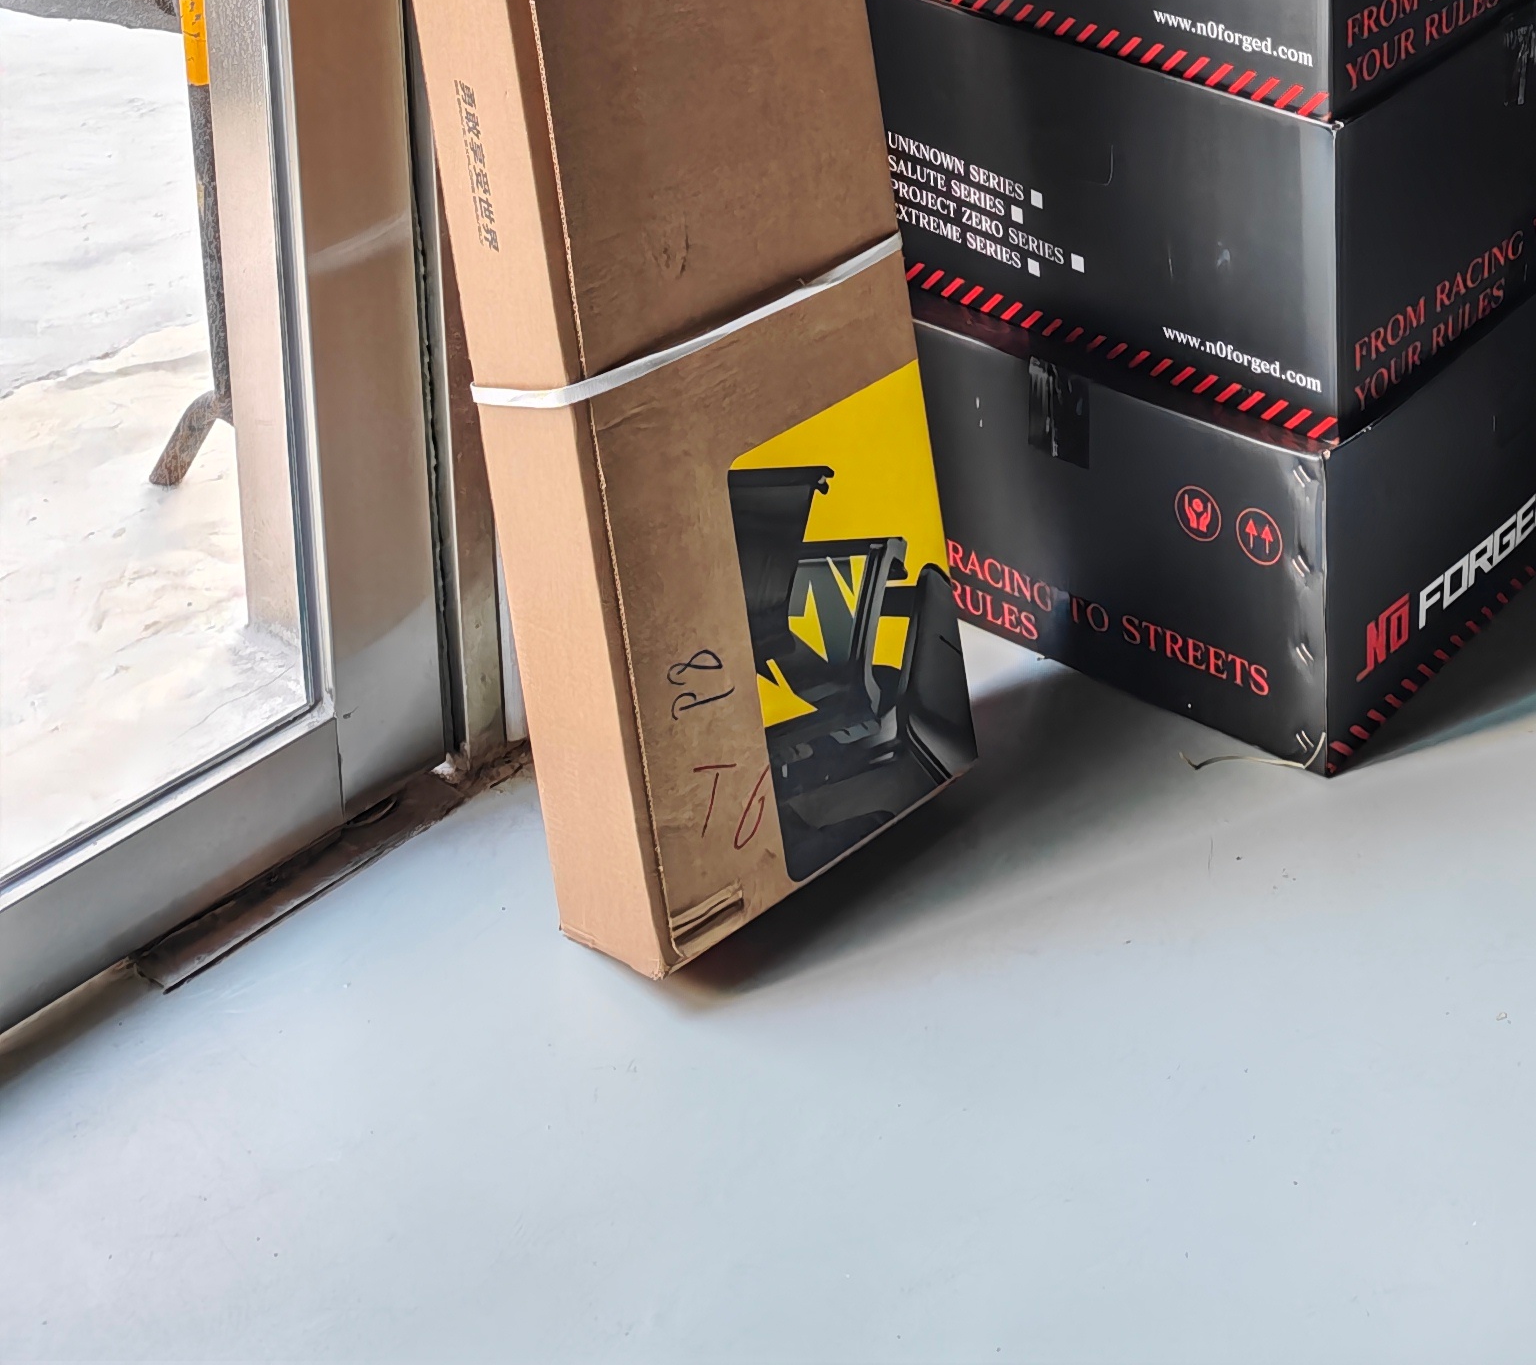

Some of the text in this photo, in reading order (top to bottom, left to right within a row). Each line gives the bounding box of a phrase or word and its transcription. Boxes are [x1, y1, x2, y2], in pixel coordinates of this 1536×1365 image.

[1153, 10, 1314, 68] www.n0forged.com
[1345, 29, 1416, 92] YOUR
[459, 80, 500, 253] 勇敢享受世界
[887, 130, 1025, 201] UNKNOWN SERIES
[887, 155, 1005, 216] SALUTE SERIES
[895, 202, 1022, 269] XTREME SERIES
[961, 207, 1004, 238] ZERO
[1008, 227, 1065, 265] SERIES
[1354, 296, 1426, 372] FROM
[1435, 230, 1524, 313] RACING
[1162, 325, 1322, 394] www.n0forged.com
[1353, 277, 1506, 412] YOUR RULES
[946, 538, 1270, 697] RACING TO STREETS
